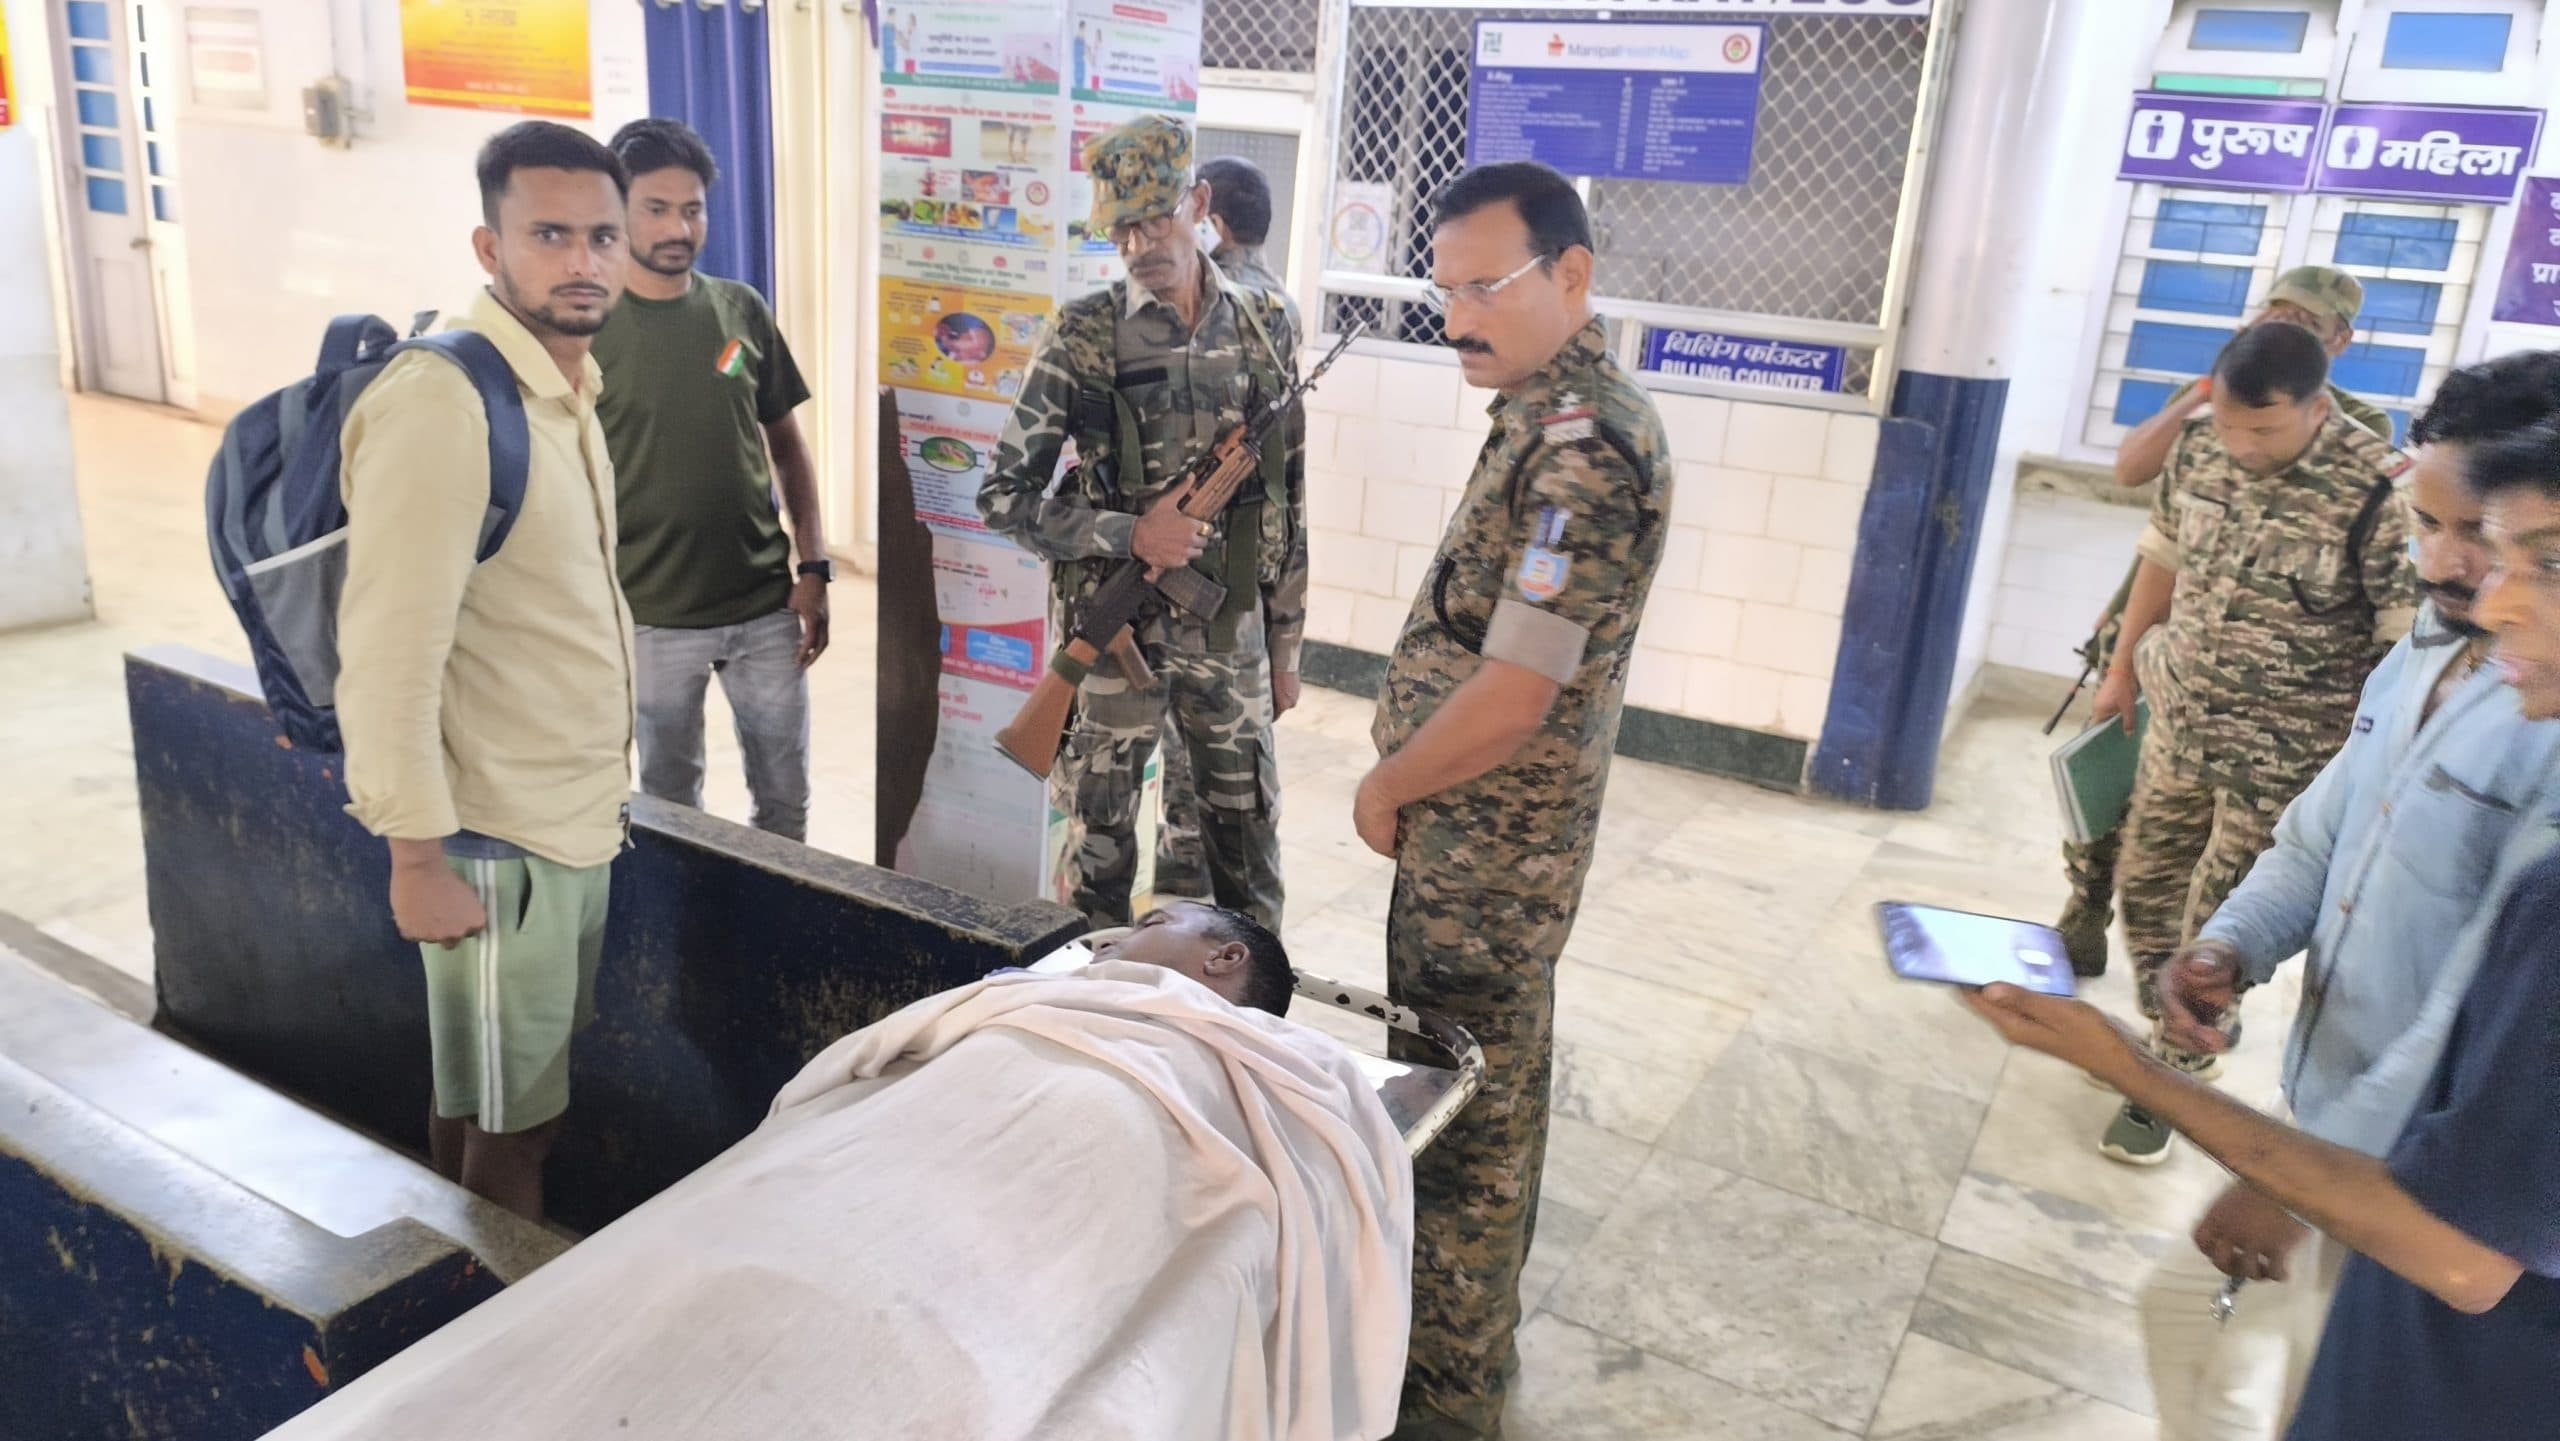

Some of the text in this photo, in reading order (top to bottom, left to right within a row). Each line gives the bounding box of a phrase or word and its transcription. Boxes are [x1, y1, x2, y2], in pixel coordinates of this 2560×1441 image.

[2189, 117, 2314, 170] पुरूष
[2379, 131, 2522, 177] महिला
[1660, 358, 1825, 392] BILLING COUNTER
